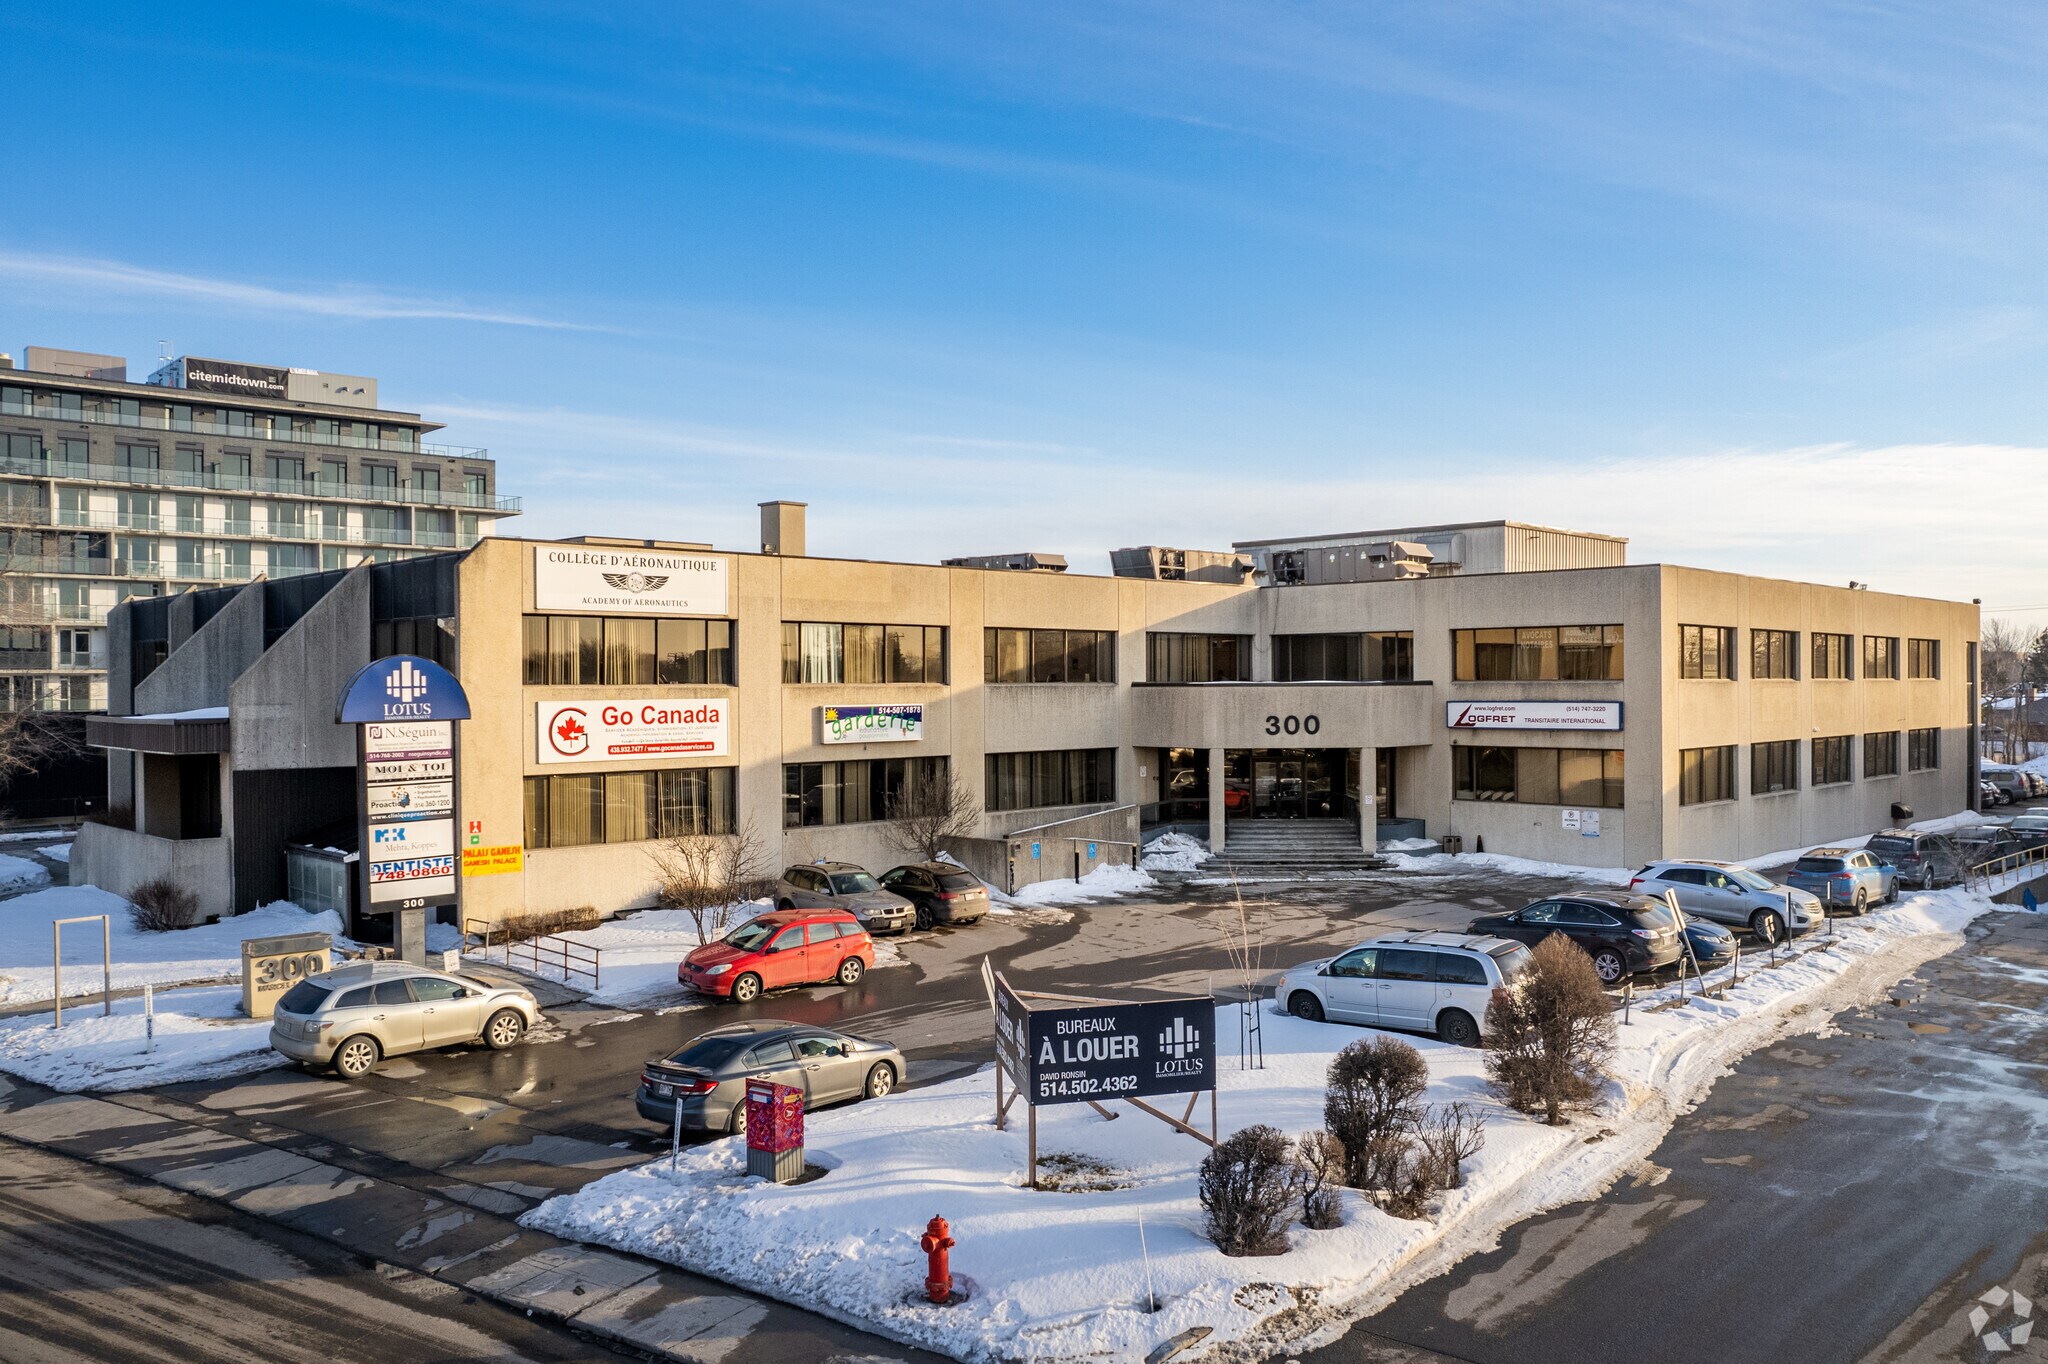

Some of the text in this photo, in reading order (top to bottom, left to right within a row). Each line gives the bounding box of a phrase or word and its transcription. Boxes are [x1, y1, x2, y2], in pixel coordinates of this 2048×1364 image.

[189, 370, 284, 390] citemidtown.com
[549, 552, 717, 571] COLLÈGE D'AÉRONAUTIQUE
[582, 597, 620, 605] ACADEMY
[634, 599, 689, 607] AERONAUTICS
[1521, 630, 1552, 640] AVOCATS
[1520, 640, 1553, 649] NOTAIRES
[383, 703, 432, 716] LOTUS
[601, 705, 720, 726] Go Canada
[878, 706, 921, 714] 514-507-1878
[1453, 704, 1516, 727] LOGFRET
[831, 706, 915, 740] garderie
[1265, 715, 1320, 735] 300
[385, 726, 437, 741] N.Séguin
[609, 745, 644, 753] 438.932.7477
[647, 744, 713, 752] www.gocanadaservices.ca
[375, 763, 445, 774] MOI & TOI
[425, 799, 450, 808] 360-1200
[371, 810, 451, 820] www.cliniqueproaction.com
[463, 846, 521, 858] PALAIS GANESH
[373, 857, 453, 874] DENTISTE
[463, 857, 517, 867] GANESH PALACE
[376, 866, 450, 881] 748-0860
[403, 899, 424, 908] 300
[255, 953, 323, 984] 300
[1057, 1017, 1116, 1035] BUREAUX
[1038, 1036, 1056, 1065] À
[1063, 1035, 1140, 1063] LOUER
[1155, 1058, 1204, 1073] LOTUS
[1040, 1070, 1087, 1082] DAVID RONSIN
[1040, 1075, 1138, 1097] 514.502.4362
